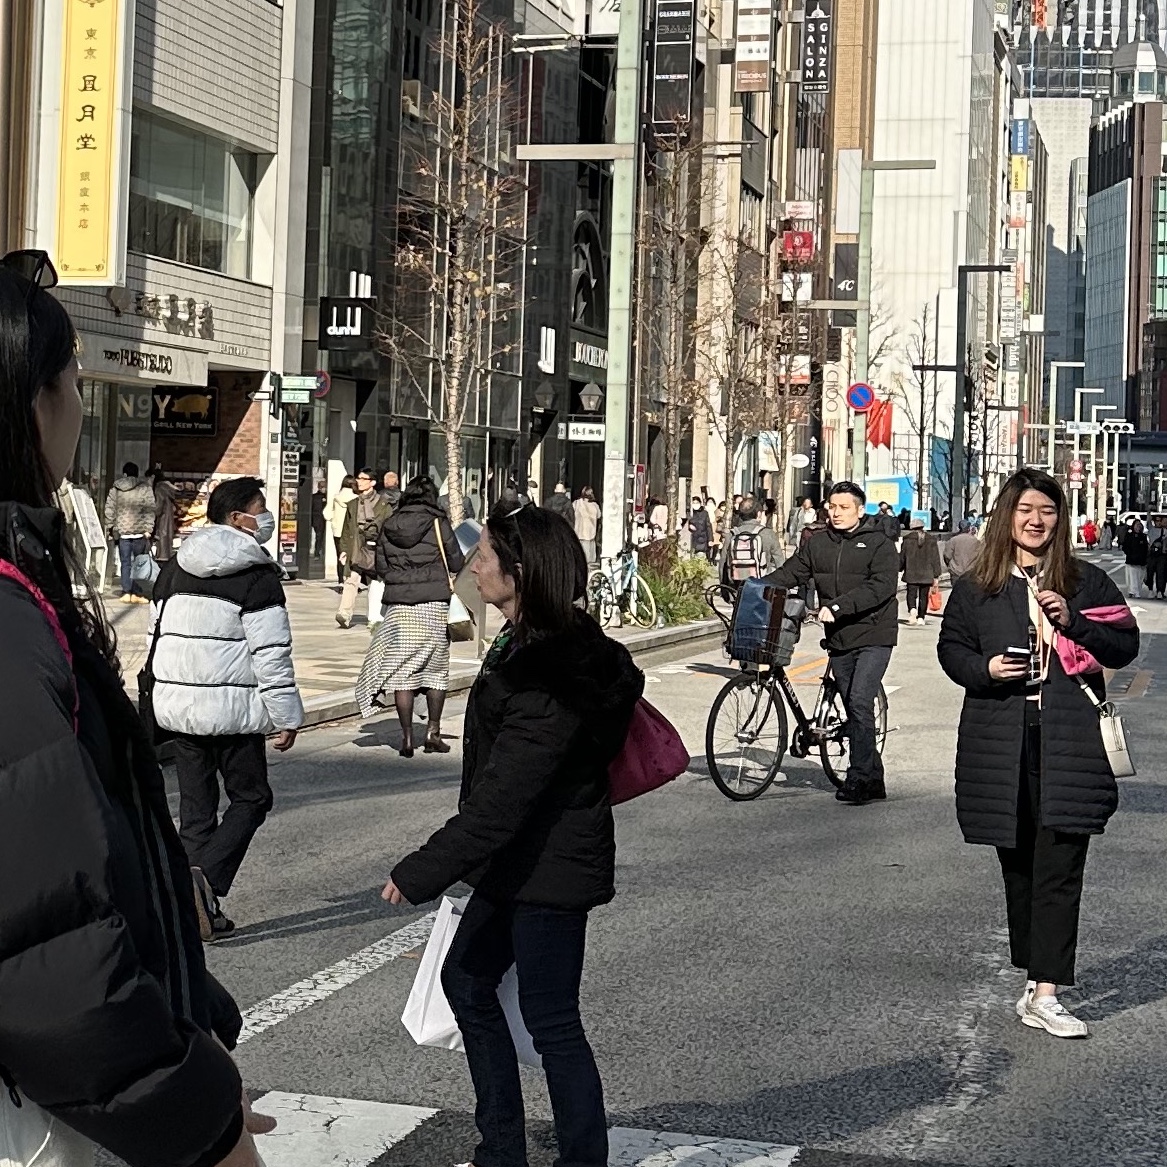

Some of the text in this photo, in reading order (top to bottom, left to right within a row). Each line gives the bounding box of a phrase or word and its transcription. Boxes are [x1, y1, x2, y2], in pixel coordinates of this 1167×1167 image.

[805, 23, 815, 79] SALON
[817, 23, 829, 79] GINZA
[825, 370, 839, 413] CHOO
